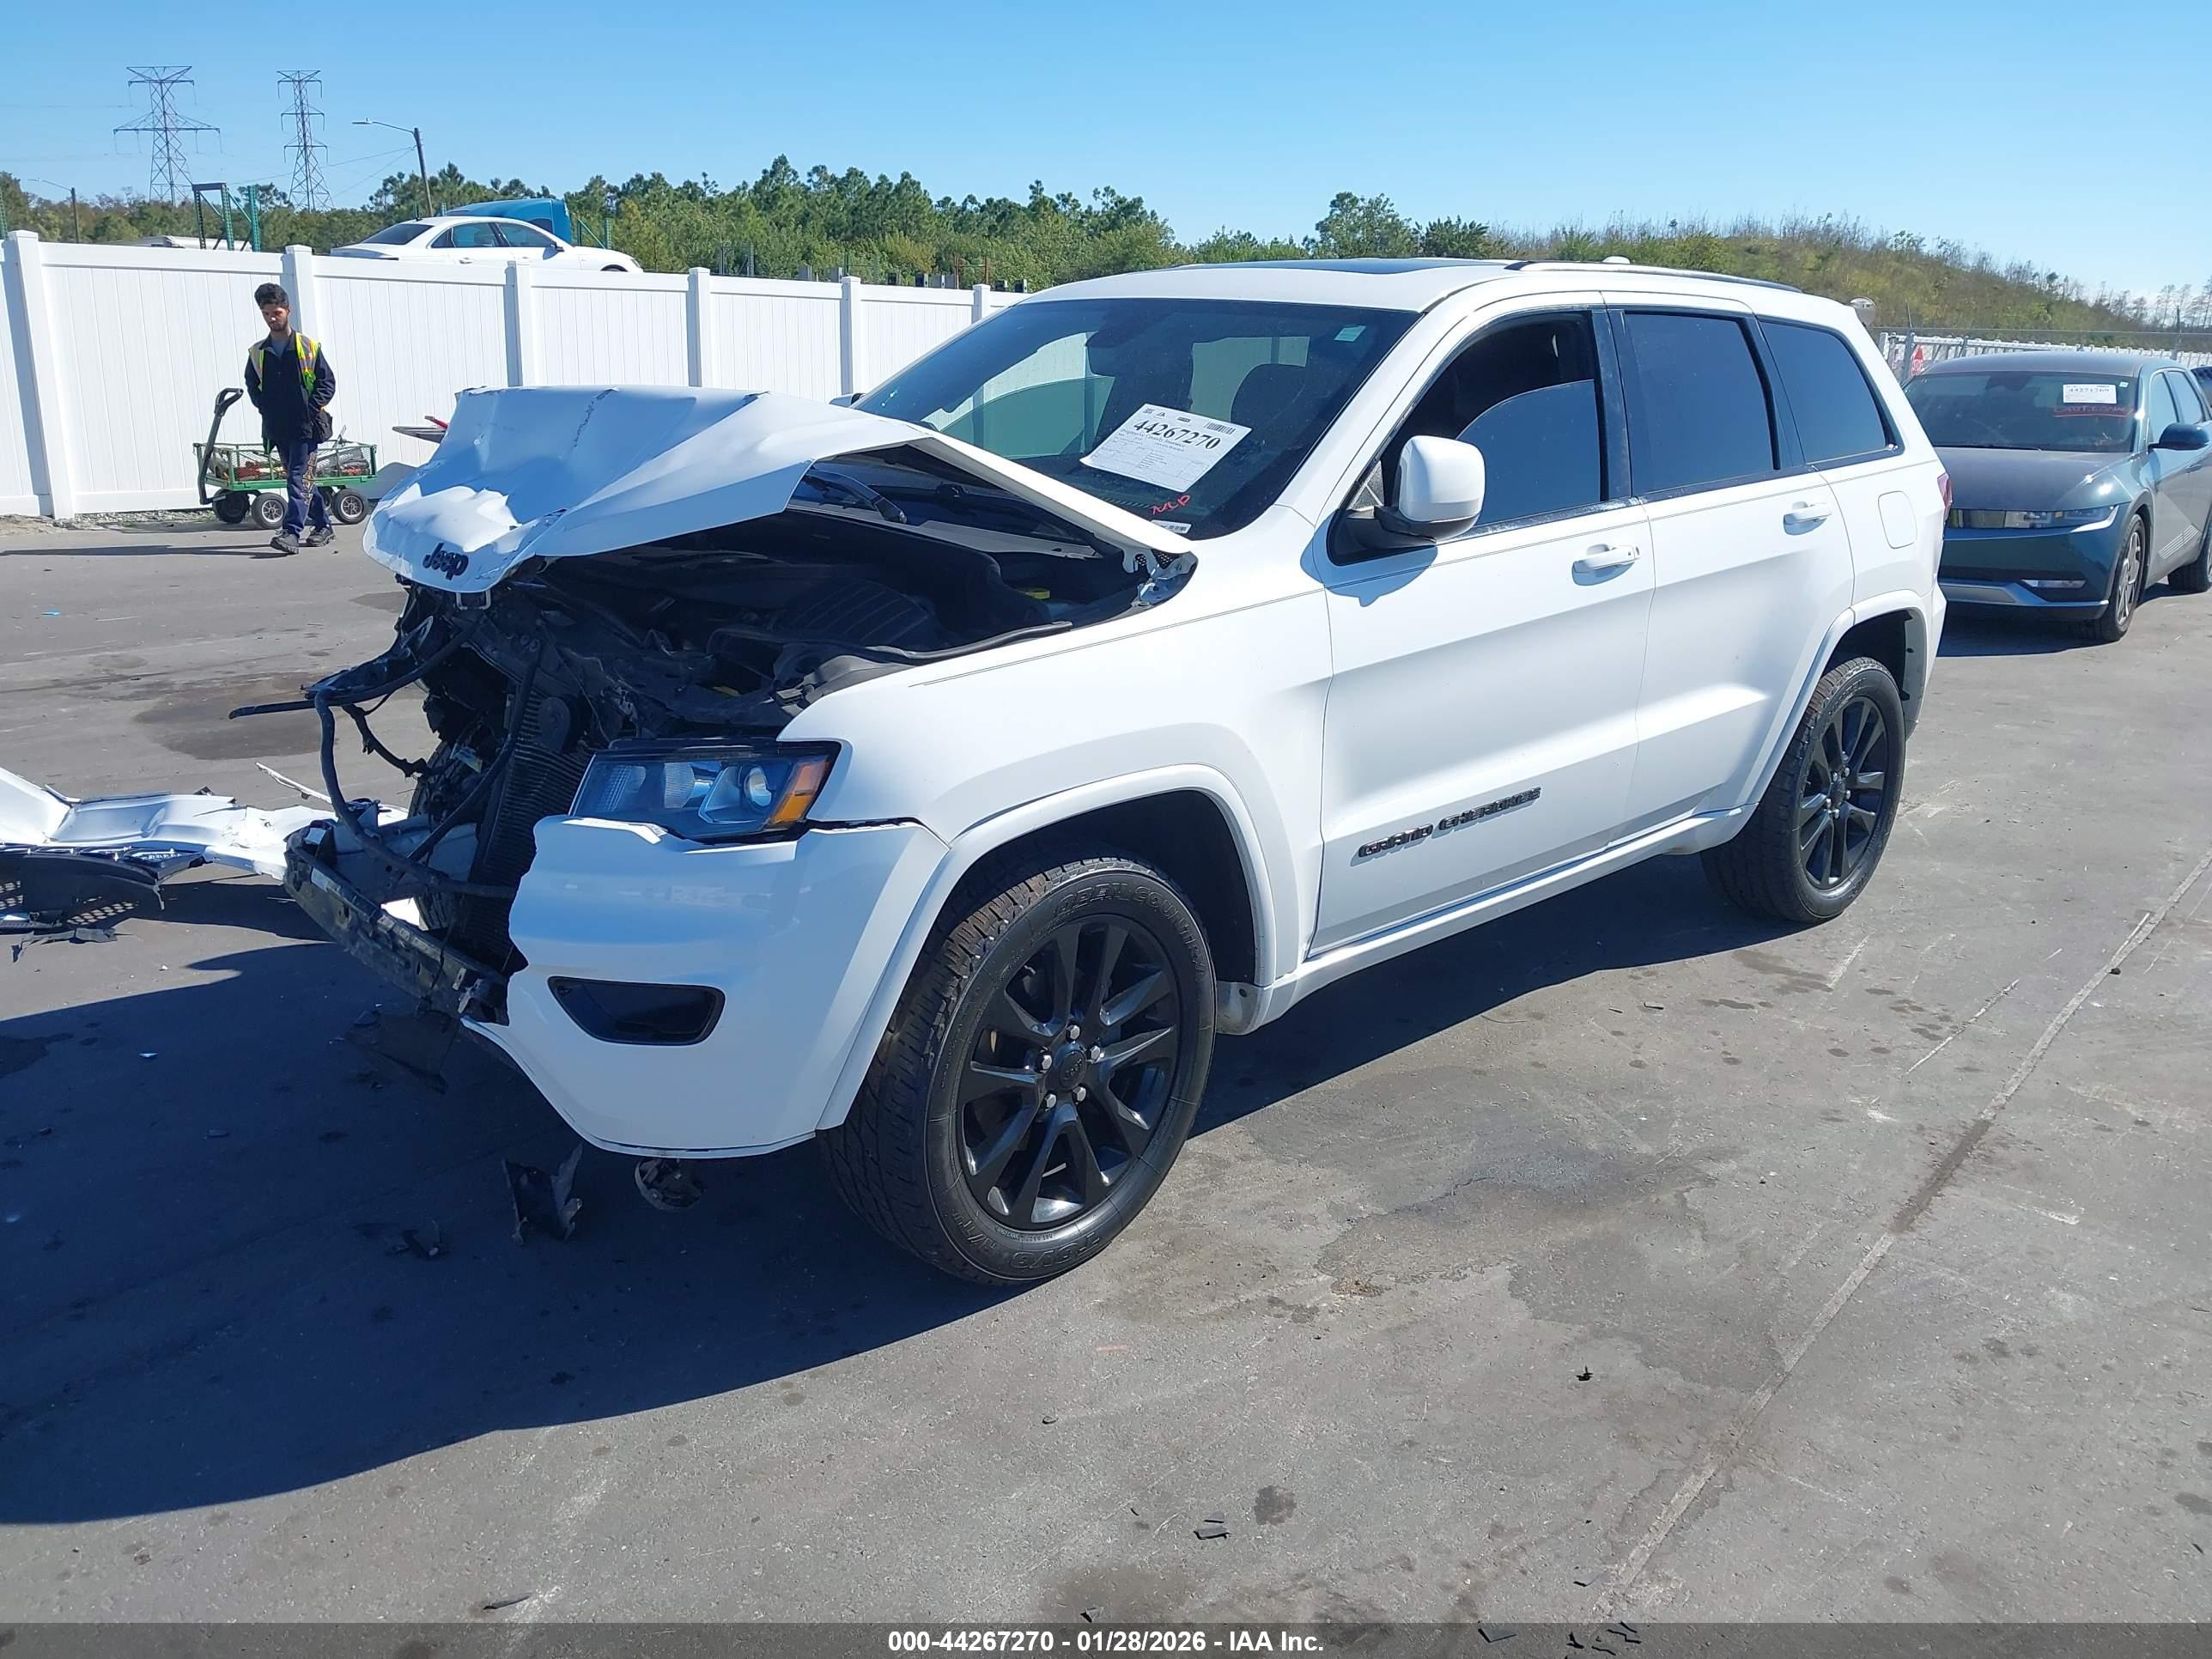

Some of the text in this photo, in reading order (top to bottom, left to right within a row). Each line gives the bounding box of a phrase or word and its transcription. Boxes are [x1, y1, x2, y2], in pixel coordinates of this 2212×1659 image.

[1133, 419, 1222, 450] 44267270
[422, 542, 469, 581] Jeep
[1358, 786, 1542, 858] GRAND CHEROKEE
